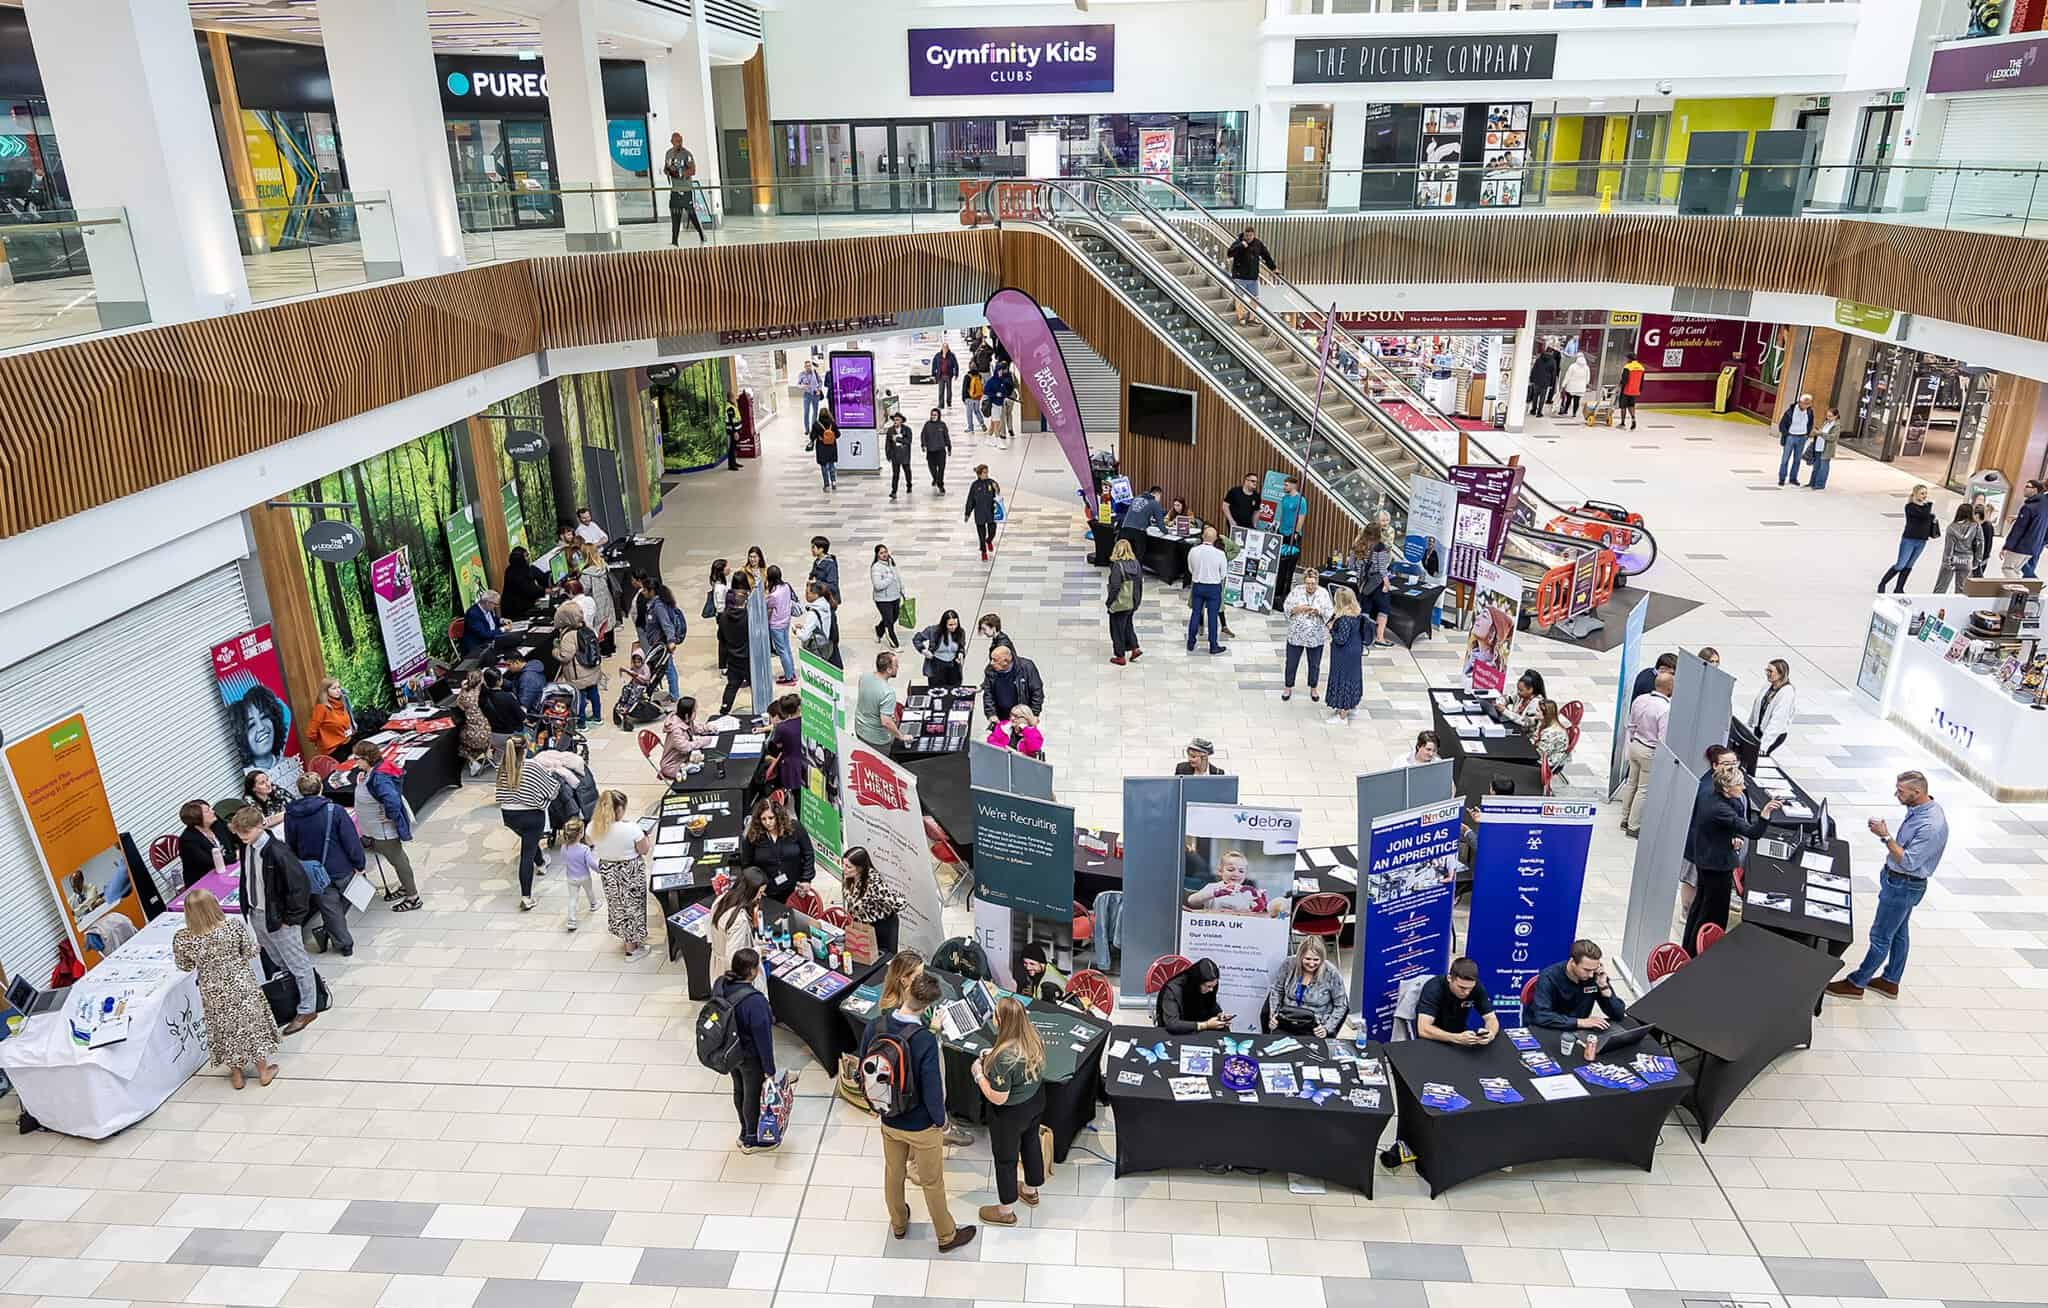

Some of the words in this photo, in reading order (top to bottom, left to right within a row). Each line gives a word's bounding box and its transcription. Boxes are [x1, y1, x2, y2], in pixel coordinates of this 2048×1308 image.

[926, 43, 1041, 69] Gymfinity
[1046, 41, 1097, 62] Kids
[1315, 47, 1348, 76] THE
[1359, 45, 1434, 75] PICTURE
[1447, 44, 1534, 73] COMPANY
[2009, 58, 2023, 68] THE
[990, 71, 1033, 82] CLUBS
[1992, 67, 2021, 79] LEXICON
[616, 138, 644, 148] MONTHLY
[622, 130, 637, 139] LOW
[620, 147, 642, 156] PRICES
[1339, 311, 1405, 322] MPSON
[720, 324, 801, 345] BRACCAN
[808, 317, 853, 335] WALK
[858, 312, 899, 330] MALL
[1644, 328, 1661, 347] G
[240, 633, 257, 649] START
[243, 638, 273, 660] SOMETHING
[864, 767, 896, 794] WE'RE
[863, 780, 898, 807] HIRING
[978, 804, 1007, 821] We're
[1010, 811, 1057, 835] Recruiting
[1248, 815, 1293, 828] debra
[1386, 838, 1413, 853] JOIN
[1416, 832, 1431, 845] US
[1433, 828, 1449, 841] AS
[1373, 857, 1390, 871] AN
[1391, 839, 1459, 866] APPRENTICE
[1190, 919, 1226, 928] DEBRA
[1229, 920, 1244, 929] UK
